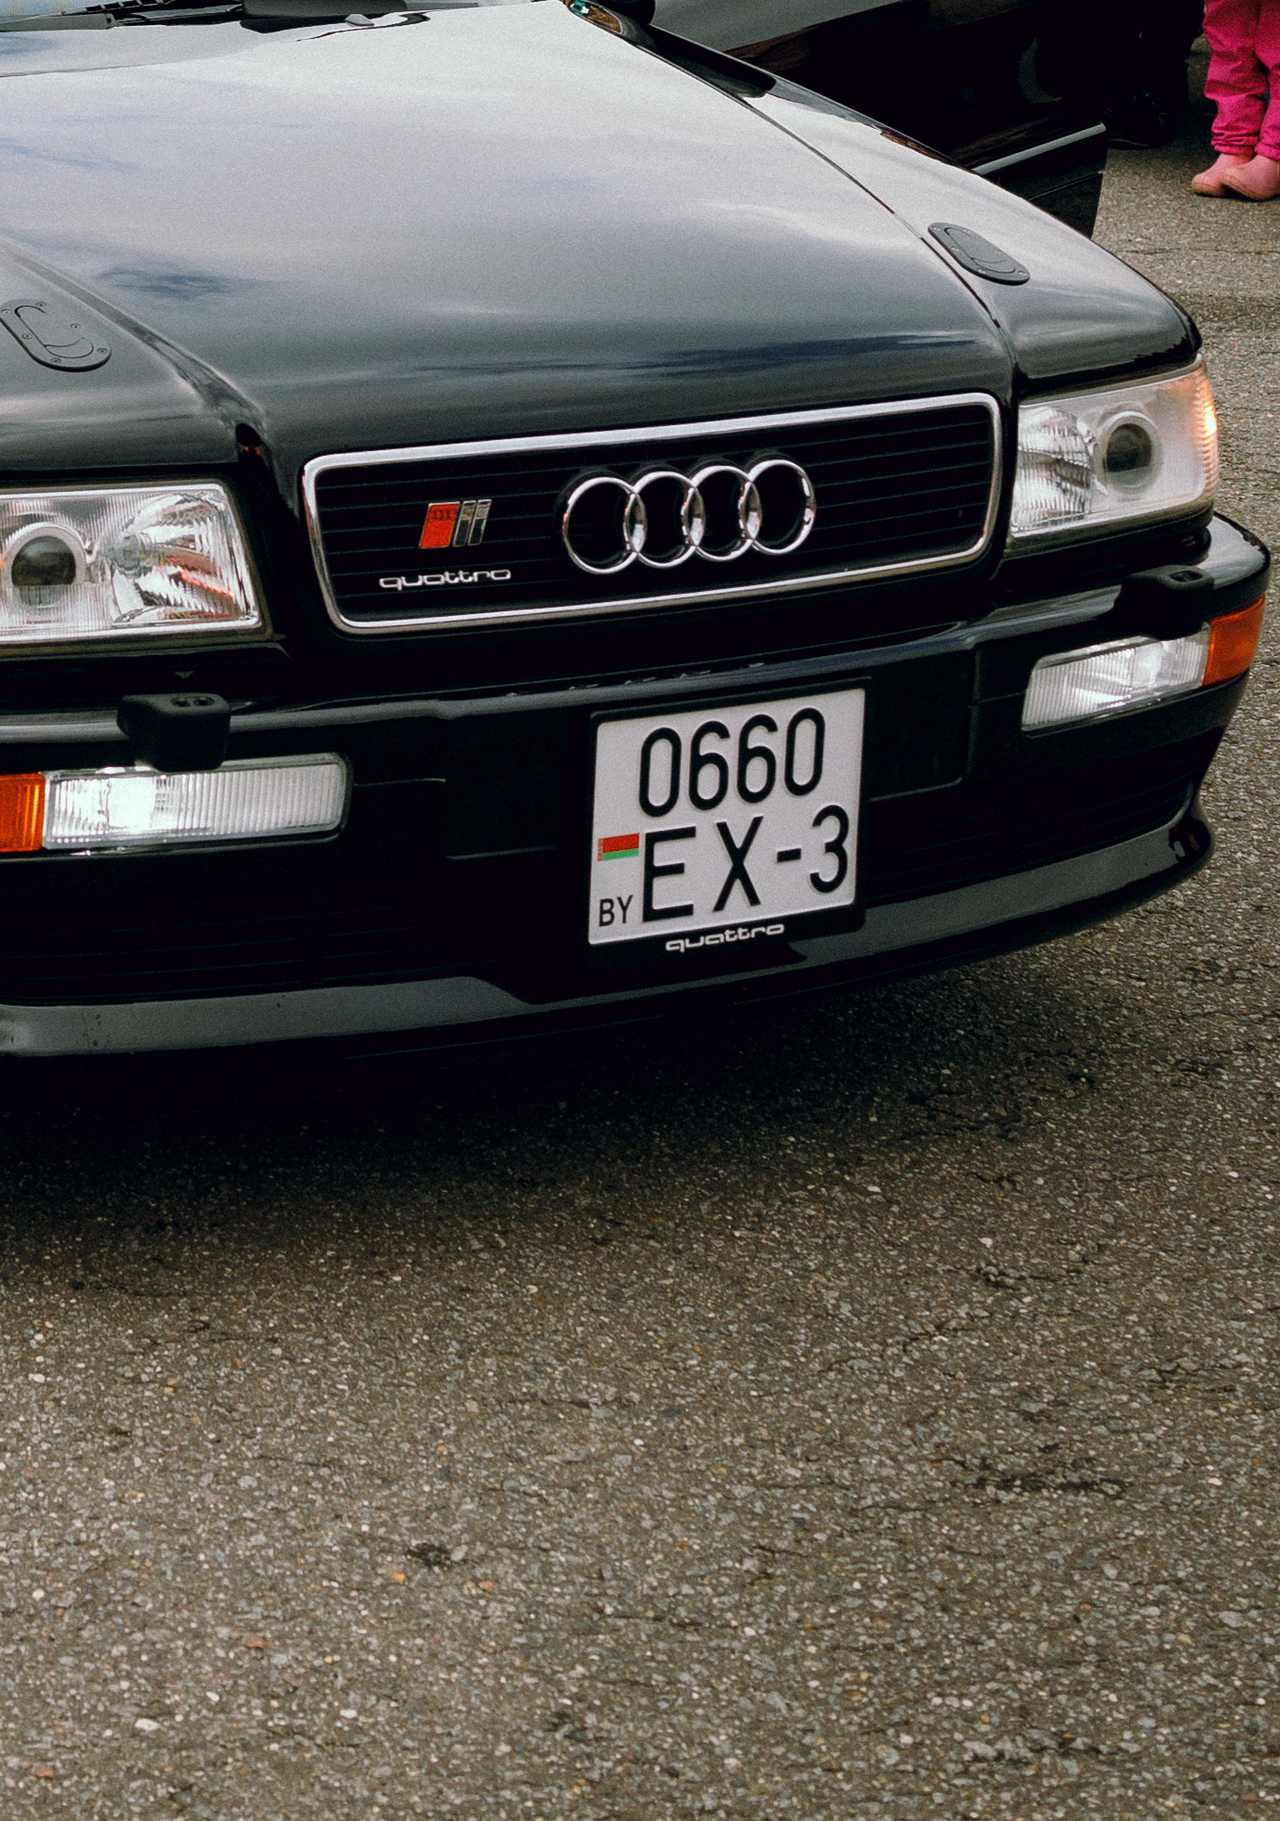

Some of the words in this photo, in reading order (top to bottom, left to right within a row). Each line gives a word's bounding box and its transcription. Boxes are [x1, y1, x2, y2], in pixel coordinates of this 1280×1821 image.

[379, 568, 511, 592] quattro
[638, 707, 826, 818] 0660
[642, 804, 850, 923] EX-3
[598, 894, 634, 927] BY
[665, 923, 785, 953] quattro
